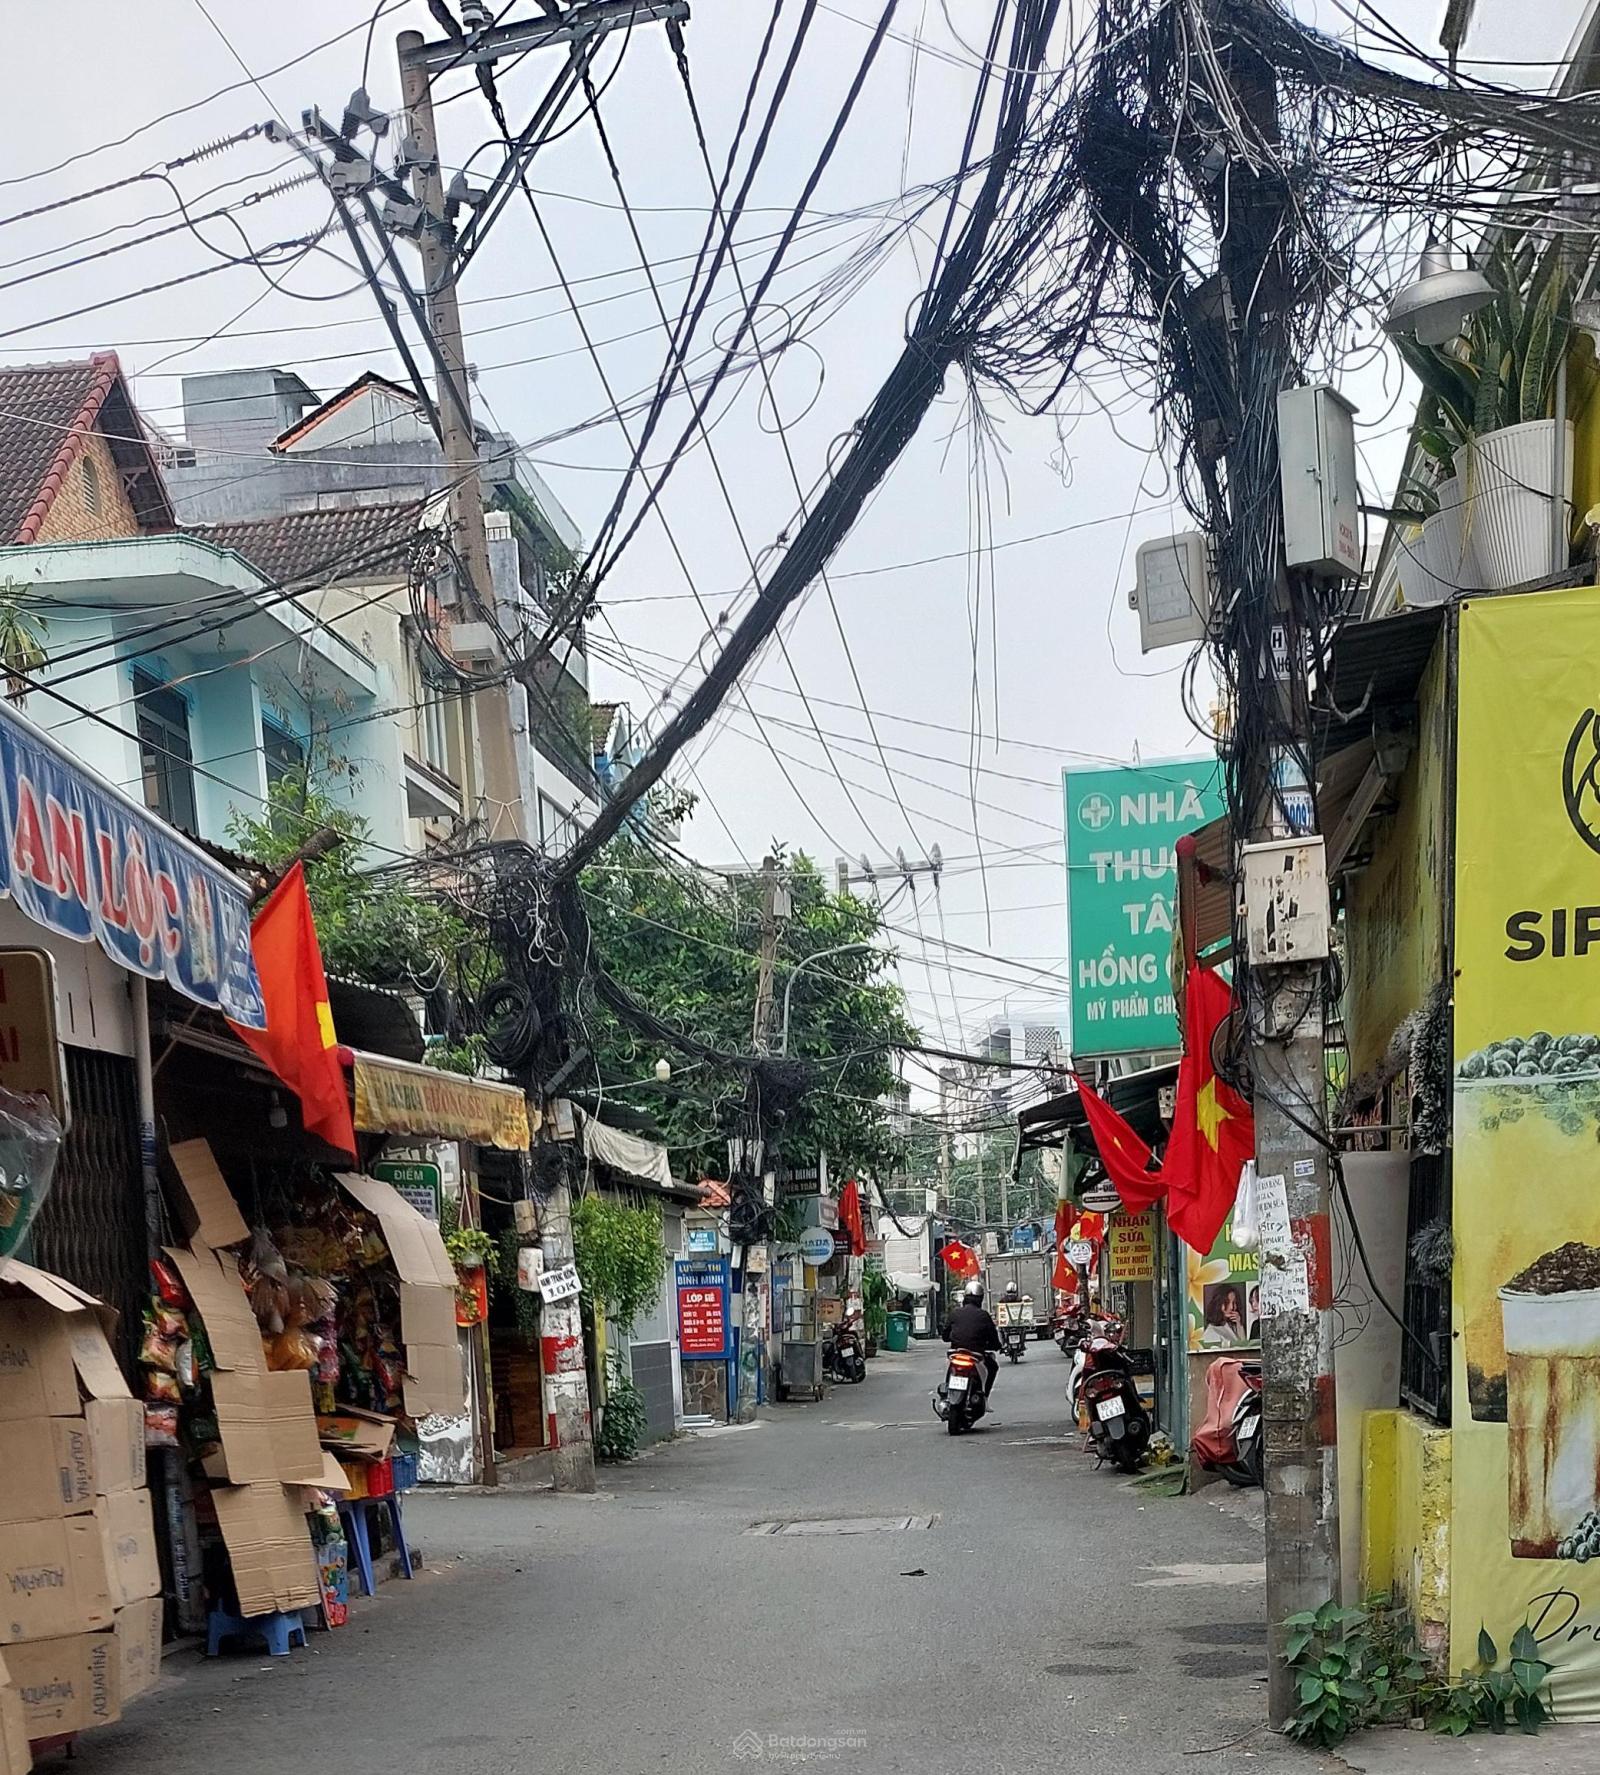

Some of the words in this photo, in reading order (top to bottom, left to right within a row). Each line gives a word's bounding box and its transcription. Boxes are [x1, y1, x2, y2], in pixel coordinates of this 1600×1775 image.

[14, 774, 90, 910] AN
[96, 825, 181, 967] LỘC
[1089, 846, 1177, 884] THU
[1122, 892, 1174, 936] TÂ
[1078, 943, 1158, 989] HỒNG
[1112, 990, 1149, 1019] PHẨM
[700, 1274, 724, 1285] MINH
